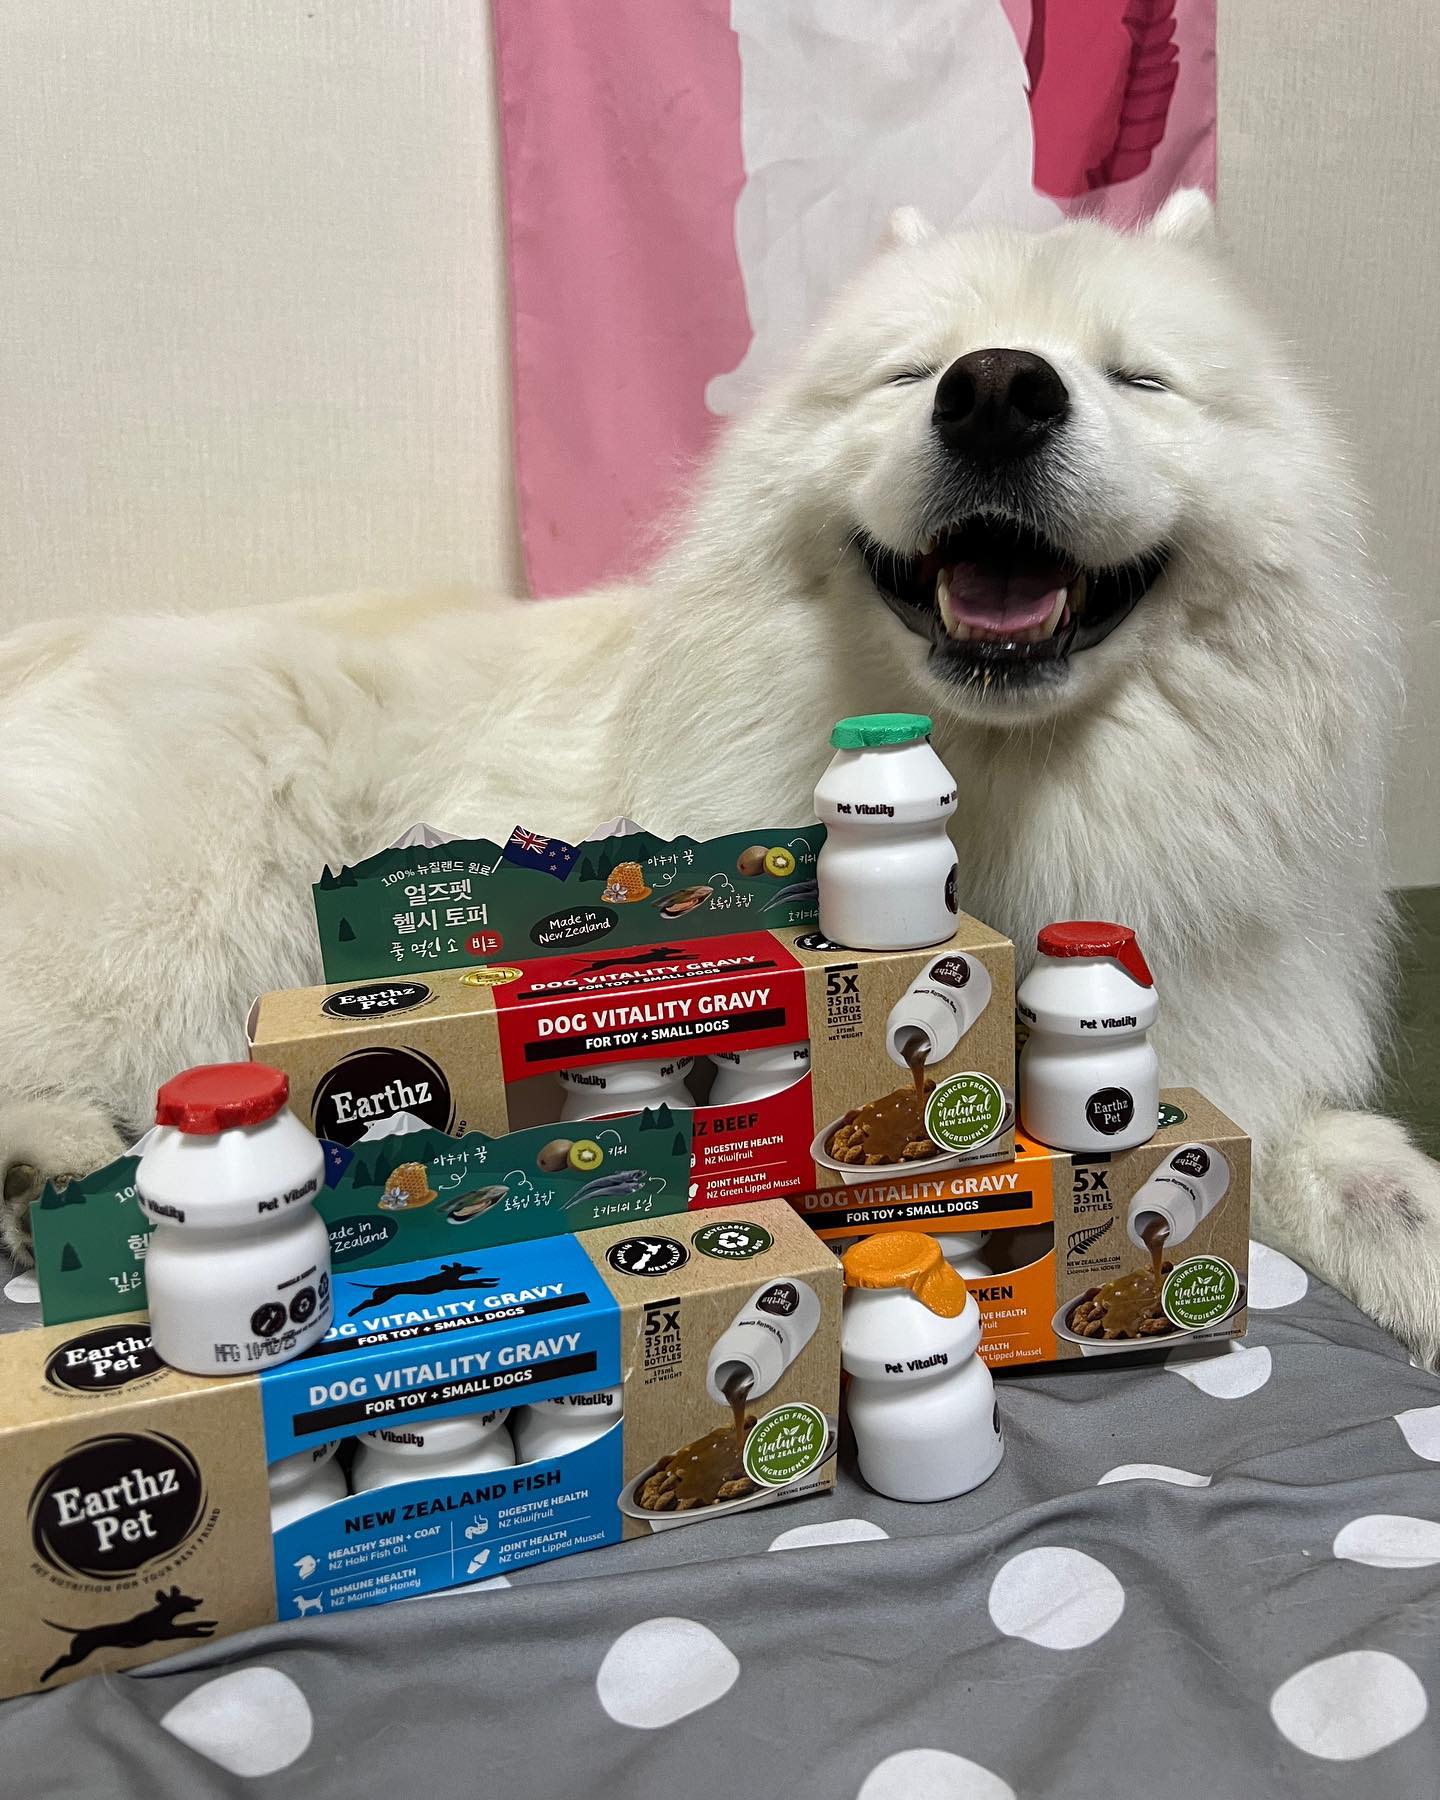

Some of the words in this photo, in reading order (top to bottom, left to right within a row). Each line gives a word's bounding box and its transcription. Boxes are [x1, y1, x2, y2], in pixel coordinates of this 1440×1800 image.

[837, 803, 851, 815] Pet
[855, 804, 894, 817] Vitality
[682, 849, 694, 866] 꿀
[381, 868, 416, 887] 100%
[417, 860, 465, 875] 뉴질랜드
[468, 862, 491, 877] 원료
[404, 878, 472, 907] 얼즈펫
[392, 909, 438, 935] 헬시
[444, 903, 488, 927] 토퍼
[549, 914, 582, 930] Made
[585, 912, 597, 921] in
[538, 931, 564, 944] New
[565, 917, 611, 938] Zealand
[389, 941, 405, 962] 풀
[411, 936, 441, 958] 먹인
[447, 938, 459, 953] 소
[472, 935, 498, 952] 비프
[530, 979, 579, 991] DOG
[583, 965, 681, 984] VITALITY
[686, 955, 756, 970] GRAVY
[578, 983, 604, 991] FOR
[642, 974, 685, 983] SMALL
[686, 968, 721, 976] DOGS
[338, 987, 415, 1005] Earthz
[360, 997, 399, 1010] Pet
[827, 993, 860, 1007] 35ml
[537, 1013, 588, 1037] DOG
[592, 998, 692, 1028] VITALITY
[698, 988, 771, 1014] GRAVY
[827, 1014, 862, 1024] BOTTLES
[828, 1005, 861, 1016] 1.18oz
[1080, 1018, 1097, 1029] Pet
[1101, 1016, 1137, 1029] Vitality
[585, 1036, 611, 1049] FOR
[613, 1032, 639, 1046] TOY
[651, 1025, 693, 1040] SMALL
[695, 1019, 730, 1034] DOGS
[793, 1048, 809, 1061] Pet
[571, 1072, 606, 1089] Vitality
[660, 1064, 674, 1077] Pet
[331, 1079, 432, 1124] Earthz
[937, 1081, 967, 1107] SOURCED
[969, 1081, 990, 1095] FROM
[939, 1094, 992, 1120] natural
[1093, 1099, 1129, 1114] Earthz
[713, 1112, 759, 1133] BEEF
[939, 1118, 956, 1127] NEW
[957, 1113, 992, 1125] ZEALAND
[1104, 1111, 1122, 1125] Pet
[941, 1123, 989, 1142] INGREDIENTS
[474, 1145, 488, 1163] 꿀
[608, 1145, 627, 1156] 키위
[704, 1140, 749, 1155] DIGESTIVE
[750, 1135, 784, 1148] HEALTH
[704, 1156, 717, 1165] NZ
[718, 1150, 753, 1162] Kiwifruit
[706, 1178, 732, 1190] JOINT
[733, 1172, 767, 1185] HEALTH
[706, 1190, 718, 1199] NZ
[719, 1187, 744, 1197] Green
[745, 1181, 772, 1193] Lipped
[773, 1177, 801, 1188] Mussel
[805, 1190, 849, 1209] DOG
[854, 1180, 945, 1205] VITALITY
[951, 1173, 1019, 1195] GRAVY
[258, 1197, 279, 1213] Pet
[283, 1178, 318, 1204] Vitality
[593, 1201, 630, 1218] 호키피쉬
[634, 1194, 653, 1212] 오일
[1073, 1190, 1111, 1205] 35ml
[846, 1211, 870, 1223] FOR
[871, 1208, 895, 1220] TOY
[906, 1203, 945, 1217] SMALL
[947, 1200, 979, 1212] DOGS
[1073, 1203, 1113, 1213] BOTTLES
[329, 1226, 354, 1241] ade
[358, 1222, 371, 1232] in
[334, 1227, 388, 1253] Zealand
[711, 1247, 746, 1256] BOTTLE
[109, 1271, 142, 1293] 깊은
[1173, 1264, 1203, 1287] SOURCED
[1205, 1264, 1224, 1276] FROM
[1174, 1275, 1226, 1300] natural
[362, 1299, 476, 1331] VITALITY
[483, 1283, 563, 1308] GRAVY
[1175, 1298, 1191, 1306] NEW
[1192, 1294, 1226, 1304] ZEALAND
[995, 1308, 1027, 1319] HEALTH
[1177, 1303, 1223, 1320] INGREDIENTS
[357, 1334, 389, 1346] FOR
[390, 1327, 419, 1339] TOY
[434, 1315, 484, 1331] SMALL
[485, 1306, 525, 1321] DOGS
[645, 1330, 682, 1348] 35ml
[978, 1342, 1010, 1352] HEALTH
[644, 1352, 682, 1367] BOTTLES
[645, 1343, 682, 1358] 1.18oz
[988, 1350, 1015, 1362] Lipped
[1015, 1347, 1042, 1357] Mussel
[92, 1354, 142, 1378] Pet
[309, 1377, 368, 1406] DOG
[374, 1351, 492, 1392] VITALITY
[497, 1332, 581, 1366] GRAVY
[884, 1361, 903, 1374] Pet
[906, 1352, 949, 1371] Vitality
[365, 1400, 396, 1415] FOR
[397, 1392, 428, 1408] TOY
[442, 1379, 491, 1399] SMALL
[493, 1369, 533, 1388] DOGS
[568, 1393, 613, 1406] Vitality
[381, 1430, 425, 1447] Vitality
[757, 1413, 790, 1443] SOURCED
[791, 1412, 813, 1425] FROM
[758, 1422, 814, 1455] natural
[758, 1453, 776, 1463] NEW
[777, 1443, 814, 1458] ZEALAND
[760, 1454, 810, 1476] INGREDIENTS
[51, 1468, 180, 1527] Earthz
[345, 1508, 396, 1534] NEW
[402, 1483, 507, 1521] ZEALAND
[513, 1469, 561, 1494] FISH
[498, 1499, 549, 1519] DIGESTIVE
[551, 1489, 589, 1506] HEALTH
[498, 1519, 512, 1529] NZ
[513, 1508, 554, 1525] Kiwifruit
[92, 1508, 157, 1552] Pet
[328, 1540, 377, 1560] HEALTHY
[379, 1535, 404, 1548] SKIN
[414, 1525, 441, 1539] COAT
[498, 1539, 528, 1554] JOINT
[529, 1530, 567, 1546] HEALTH
[499, 1554, 512, 1564] NZ
[514, 1548, 540, 1559] Green
[542, 1538, 572, 1553] Lipped
[574, 1530, 605, 1545] Mussel
[328, 1560, 343, 1571] NZ
[345, 1554, 368, 1567] Hoki
[371, 1548, 391, 1560] Fish
[393, 1544, 408, 1555] Oil
[330, 1578, 374, 1596] IMMUNE
[376, 1568, 416, 1585] HEALTH
[331, 1596, 345, 1607] NZ
[347, 1586, 388, 1602] Manuka
[389, 1578, 421, 1592] Honey
